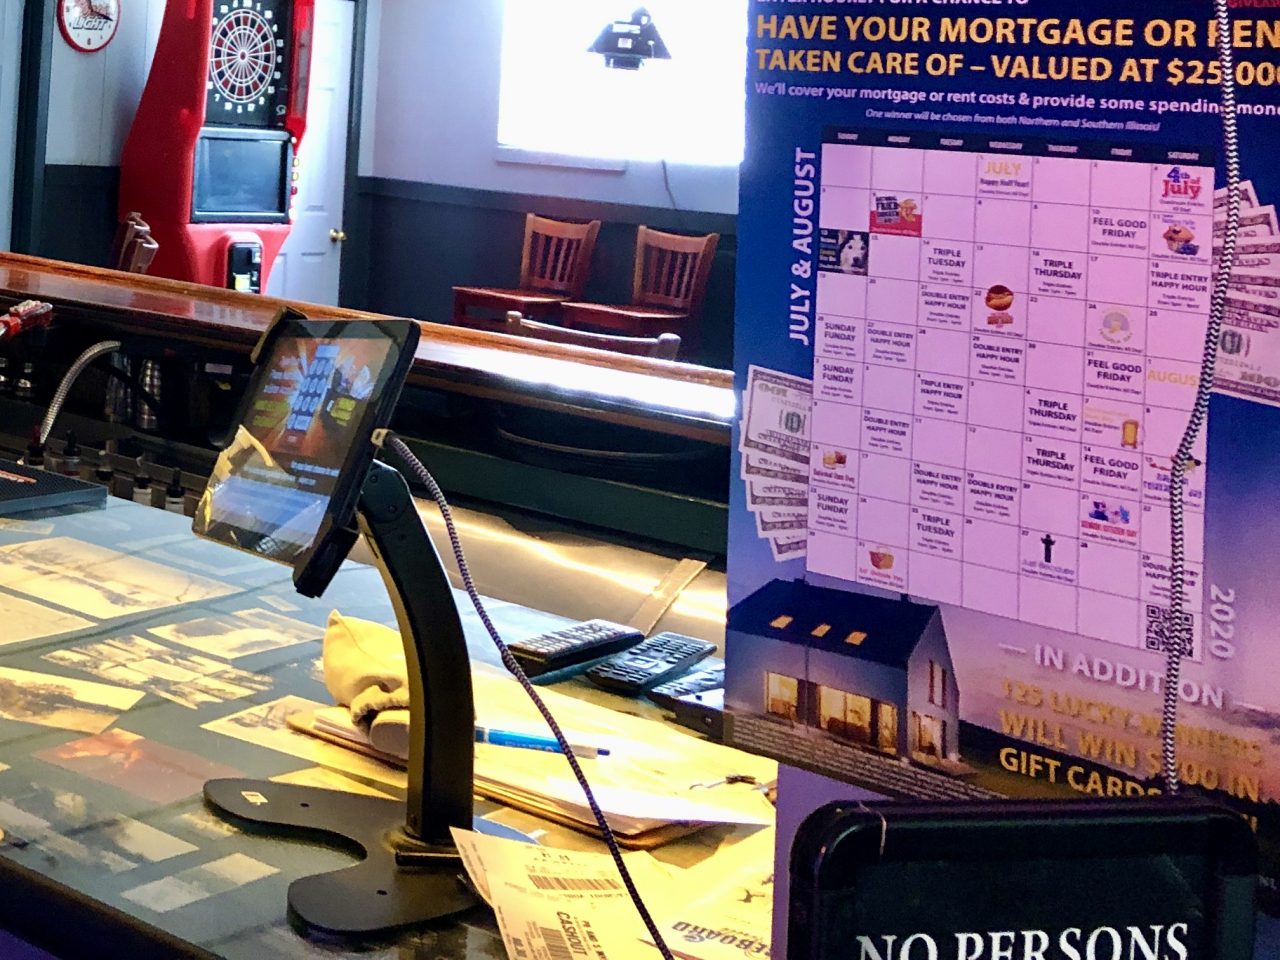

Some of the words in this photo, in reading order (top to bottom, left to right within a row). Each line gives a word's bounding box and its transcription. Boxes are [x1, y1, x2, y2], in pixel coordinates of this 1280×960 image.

[73, 16, 107, 30] LIGHT
[756, 15, 837, 40] HAVE
[845, 16, 930, 42] YOUR
[939, 17, 1134, 46] MORTGAGE
[1144, 19, 1197, 47] OR
[755, 49, 840, 73] TAKEN
[847, 50, 919, 75] CARE
[925, 53, 964, 76] OF
[990, 54, 1112, 81] VALUED
[1120, 58, 1159, 83] AT
[1166, 58, 1280, 87] $2500
[754, 82, 785, 95] We'll
[788, 85, 824, 97] cover
[826, 87, 857, 100] your
[860, 86, 926, 103] mortgage
[931, 92, 944, 102] or
[947, 90, 976, 103] rent
[979, 92, 1015, 105] costs
[1018, 93, 1030, 106] &
[1033, 93, 1095, 109] provide
[1100, 98, 1145, 110] some
[1149, 98, 1228, 115] spendin
[930, 112, 940, 121] be
[985, 161, 1021, 175] JULY
[1162, 179, 1202, 199] July
[792, 147, 816, 254] AUGUST
[1093, 217, 1114, 226] FEEL
[1117, 219, 1147, 229] GOOD
[1102, 228, 1137, 239] FRIDAY
[933, 248, 961, 258] TRIPLE
[790, 257, 812, 279] &
[928, 257, 966, 268] TUESDAY
[1043, 259, 1073, 269] TRIPLE
[1034, 268, 1082, 280] THURSDAY
[1151, 271, 1179, 281] TRIPLE
[1181, 274, 1208, 283] ENTRY
[1151, 281, 1179, 291] HAPPY
[1182, 283, 1208, 292] HOUR
[789, 284, 811, 346] JULY
[824, 322, 856, 333] SUNDAY
[824, 331, 856, 342] FUNDAY
[973, 342, 1000, 353] DOUBLE
[1001, 346, 1023, 355] ENTRY
[976, 352, 999, 361] HAPPY
[1000, 355, 1020, 364] HOUR
[822, 363, 854, 375] SUNDAY
[1088, 358, 1109, 370] FEEL
[1112, 362, 1142, 374] GOOD
[822, 373, 854, 384] FUNDAY
[1097, 371, 1132, 383] FRIDAY
[1147, 369, 1200, 386] AUGUS
[921, 378, 941, 389] TRIPLE
[943, 381, 963, 391] ENTRY
[921, 387, 942, 397] HAPPY
[943, 390, 963, 399] HOUR
[1038, 399, 1068, 411] TRIPLE
[1028, 407, 1077, 422] THURSDAY
[863, 415, 888, 426] DOUBLE
[890, 419, 910, 428] ENTRY
[866, 424, 887, 434] HAPPY
[888, 428, 906, 437] HOUR
[1036, 448, 1066, 460] TRIPLE
[1026, 456, 1075, 472] THURSDAY
[1084, 454, 1106, 465] FEEL
[1108, 458, 1139, 471] GOOD
[913, 468, 939, 479] DOUBLE
[941, 473, 962, 483] ENTRY
[1093, 467, 1128, 480] FRIDAY
[916, 477, 938, 487] HAPPY
[939, 481, 959, 491] HOUR
[817, 493, 849, 505] SUNDAY
[817, 503, 848, 515] FUNDAY
[922, 513, 950, 526] TRIPLE
[917, 523, 955, 538] TUESDAY
[1209, 587, 1235, 659] 2020
[1033, 643, 1064, 671] IN
[1072, 653, 1225, 709] ADDITON
[1049, 690, 1131, 730] LUCKY
[999, 709, 1068, 751] WILL
[1077, 732, 1137, 769] WIN
[1145, 749, 1221, 790] $00
[1227, 772, 1261, 802] IN
[999, 746, 1062, 784] GIFT
[556, 910, 588, 957] CASHOUT
[856, 932, 938, 960] NO
[954, 922, 1188, 960] PERSONS
